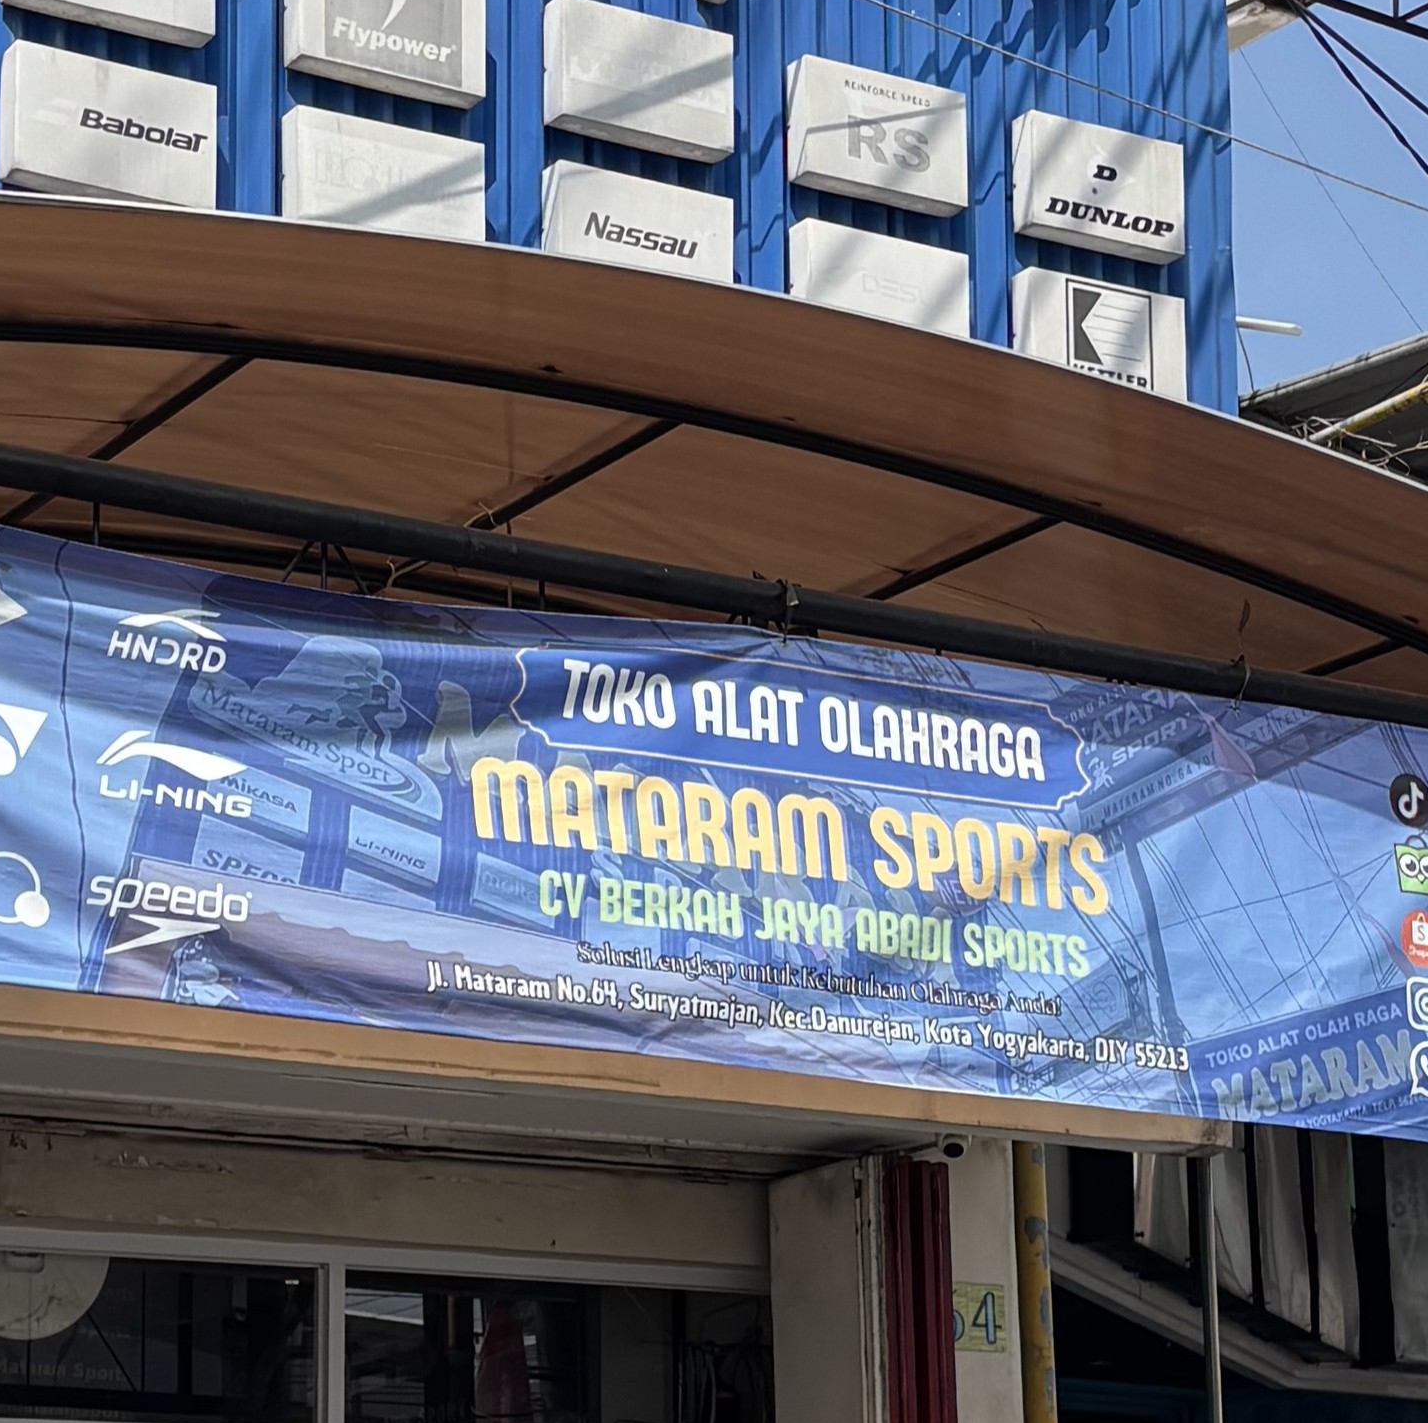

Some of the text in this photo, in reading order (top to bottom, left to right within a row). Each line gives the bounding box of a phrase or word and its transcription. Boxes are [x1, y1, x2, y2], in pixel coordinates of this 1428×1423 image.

[332, 16, 453, 63] Flypower
[847, 114, 931, 173] RS
[584, 212, 699, 259] Nassau
[1045, 197, 1174, 237] DUNLOP
[202, 684, 391, 784] Mataram Sport
[563, 658, 1045, 782] TOKO ALAT OLAHRAGA
[99, 776, 252, 818] LI-NING
[355, 836, 426, 870] LI-NING
[472, 757, 1110, 917] MATARAM SPORTS
[87, 875, 250, 921] speedo
[539, 869, 1090, 978] CV BERKAH JAYA ABADI SPORTS
[576, 941, 643, 969] Solusi
[645, 948, 734, 984] Lengkap
[910, 981, 1002, 1015] Olahraga
[454, 964, 551, 1000] Mataram
[556, 974, 624, 1011] No.64,
[629, 983, 764, 1028] Suryatmajan,
[769, 1002, 921, 1045] Kec.Danurejan,
[924, 1017, 972, 1046] Kota
[978, 1023, 1091, 1063] Yogyakarta,
[1095, 1036, 1129, 1064] DIY
[1134, 1041, 1190, 1071] 55213
[1206, 1003, 1402, 1068] TOKO ALAT OLAH RAGA
[1212, 1030, 1415, 1122] MATARAM
